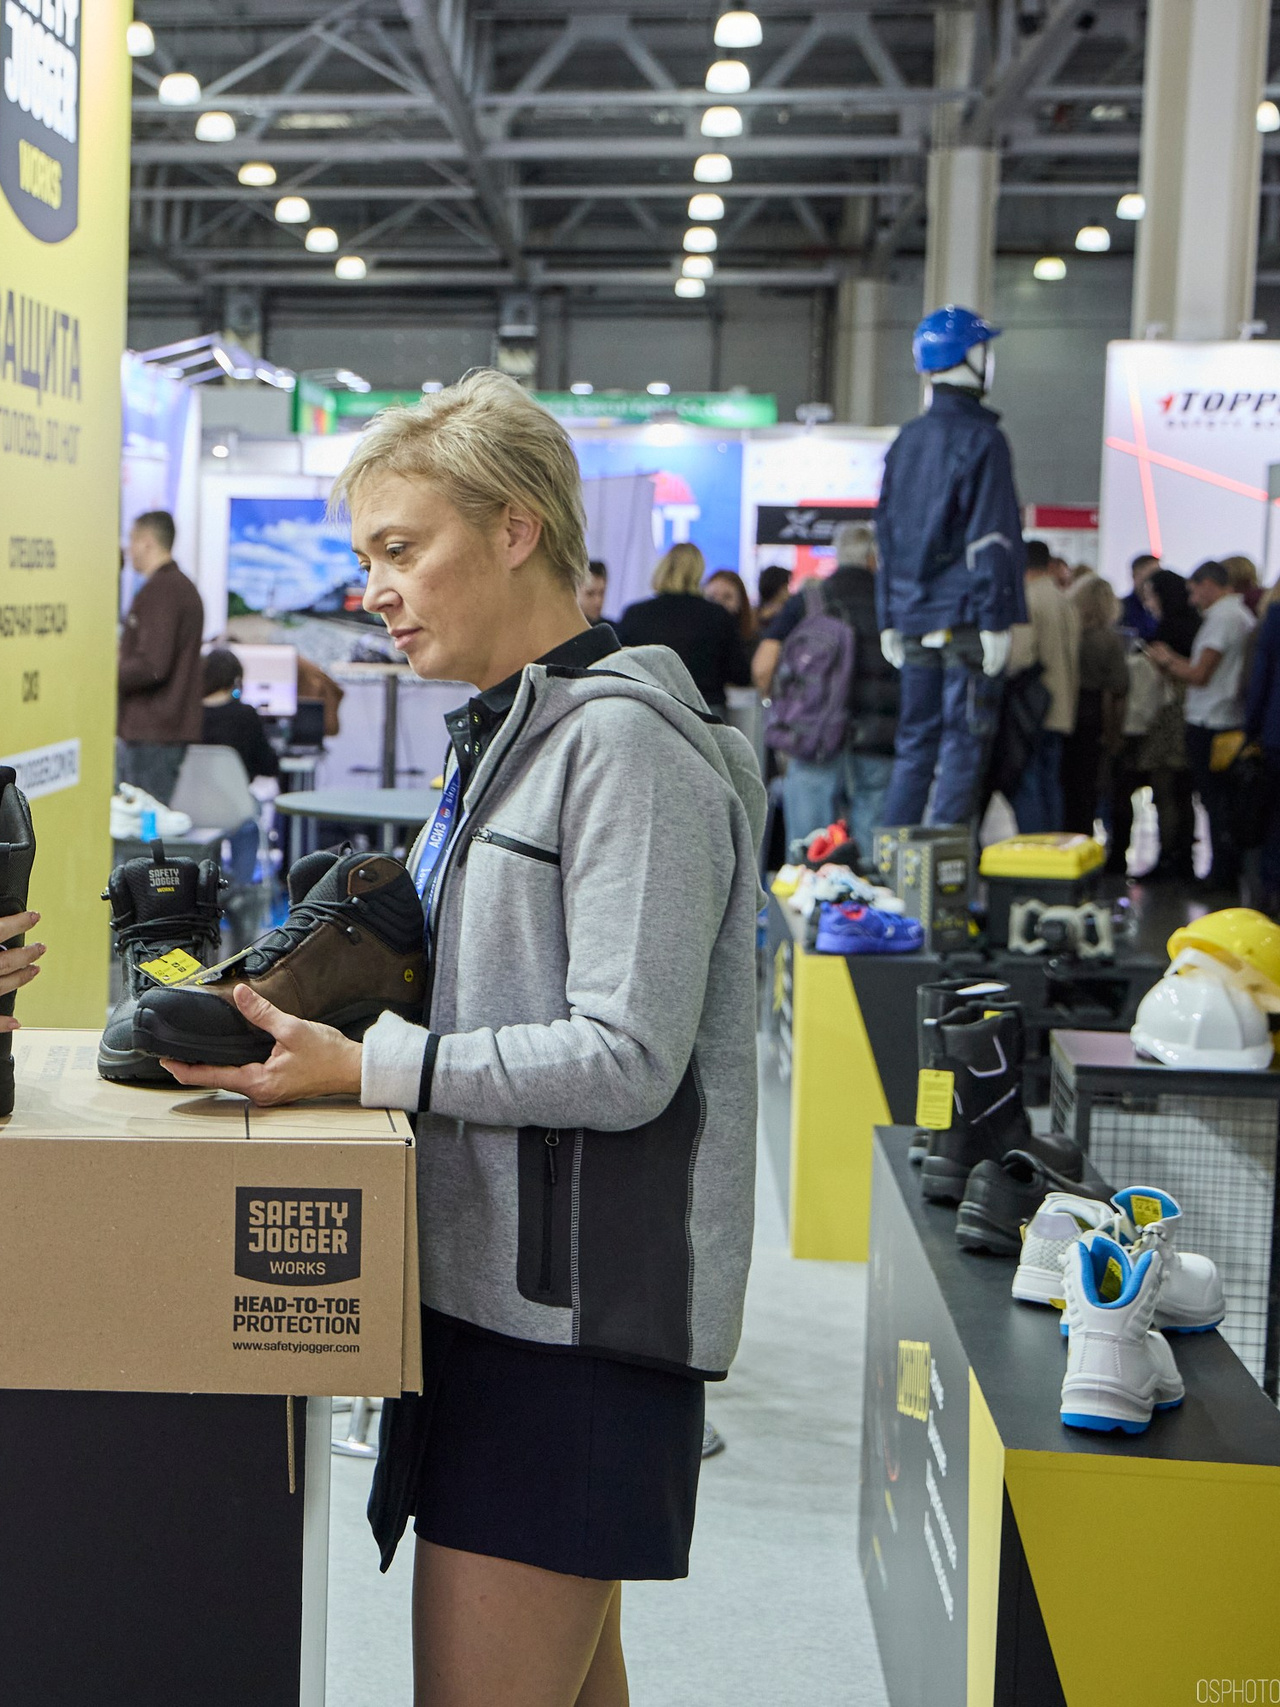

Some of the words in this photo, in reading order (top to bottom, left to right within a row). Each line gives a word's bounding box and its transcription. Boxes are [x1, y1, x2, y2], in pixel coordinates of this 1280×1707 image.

[1180, 392, 1280, 412] TOPP
[428, 821, 447, 848] АСИЗ
[149, 868, 180, 878] SAFETY
[150, 877, 180, 887] JOGGER
[248, 1200, 349, 1227] SAFETY
[248, 1227, 348, 1254] JOGGER
[270, 1261, 326, 1275] WORKS
[234, 1296, 360, 1314] HEAD-TO-TOE
[233, 1314, 360, 1335] PROTECTION
[232, 1341, 360, 1354] www.safetyjogger.com
